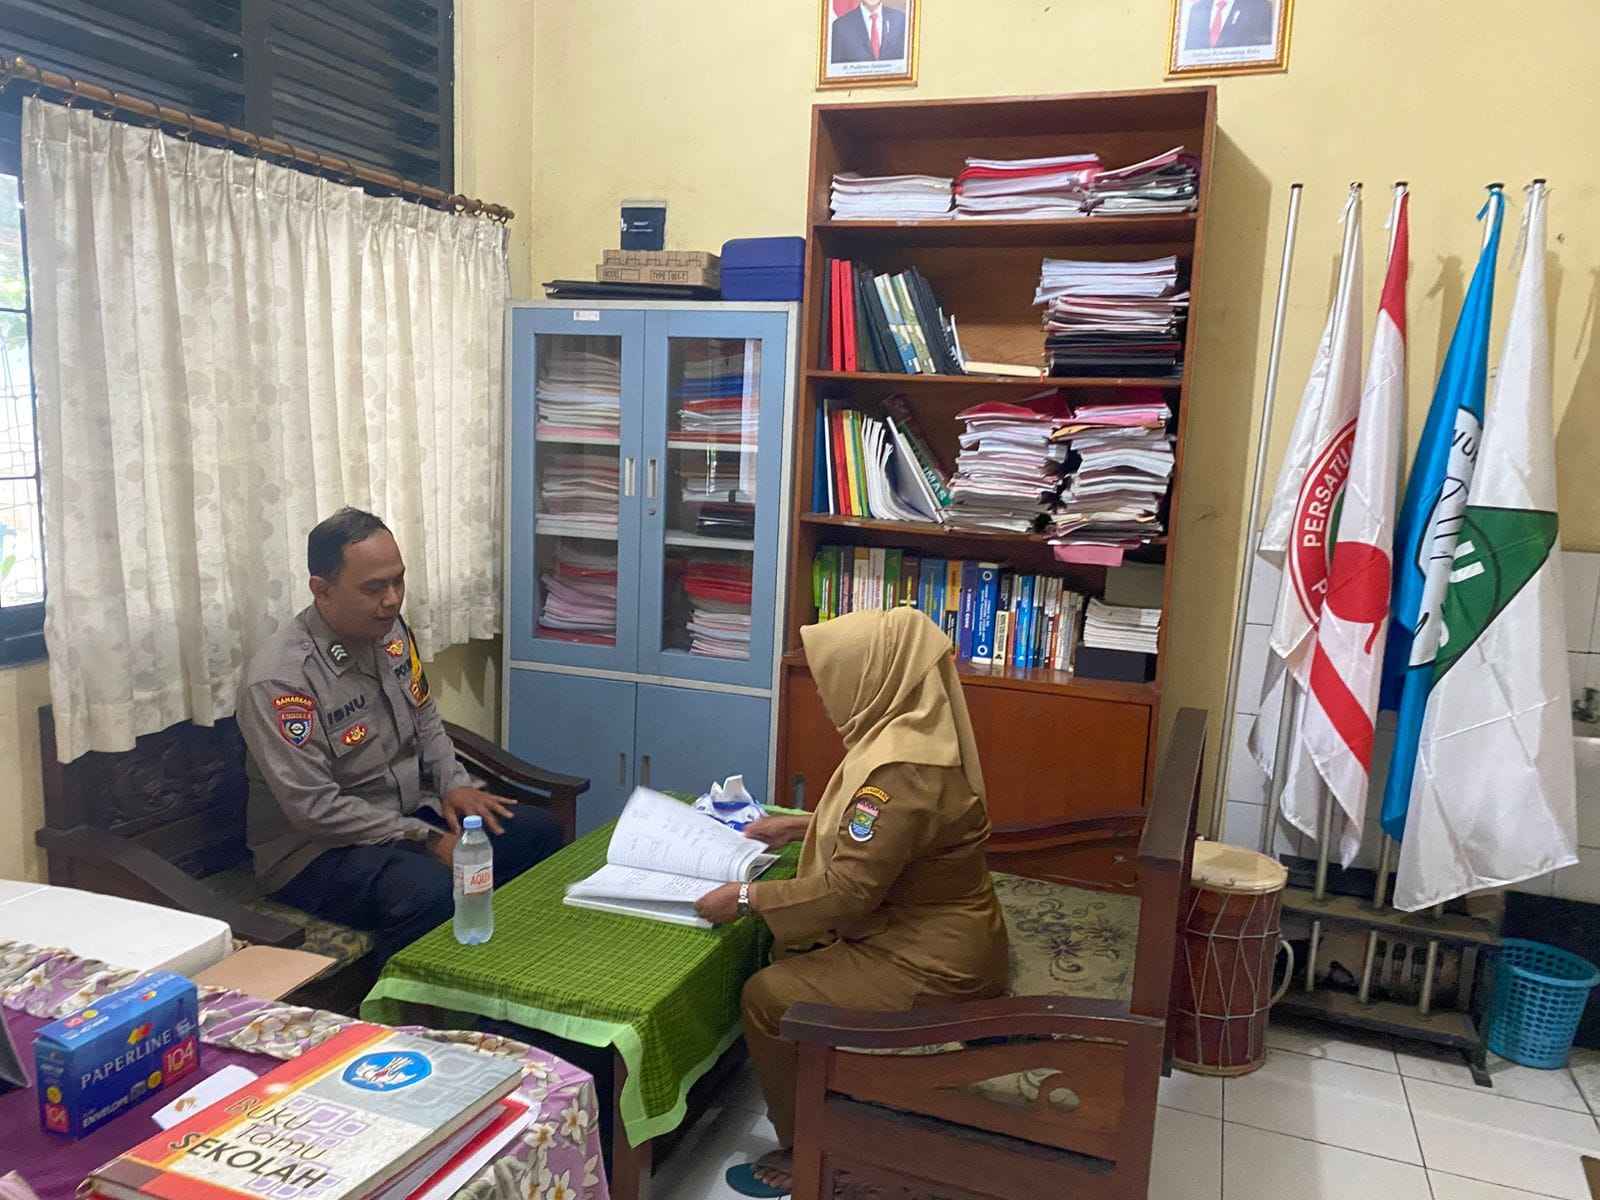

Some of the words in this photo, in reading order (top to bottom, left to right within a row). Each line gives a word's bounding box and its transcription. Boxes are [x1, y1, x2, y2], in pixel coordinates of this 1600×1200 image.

[1303, 440, 1353, 547] PERSATU
[81, 1029, 173, 1090] PAPERLINE
[169, 1132, 329, 1190] SEKOLAH
